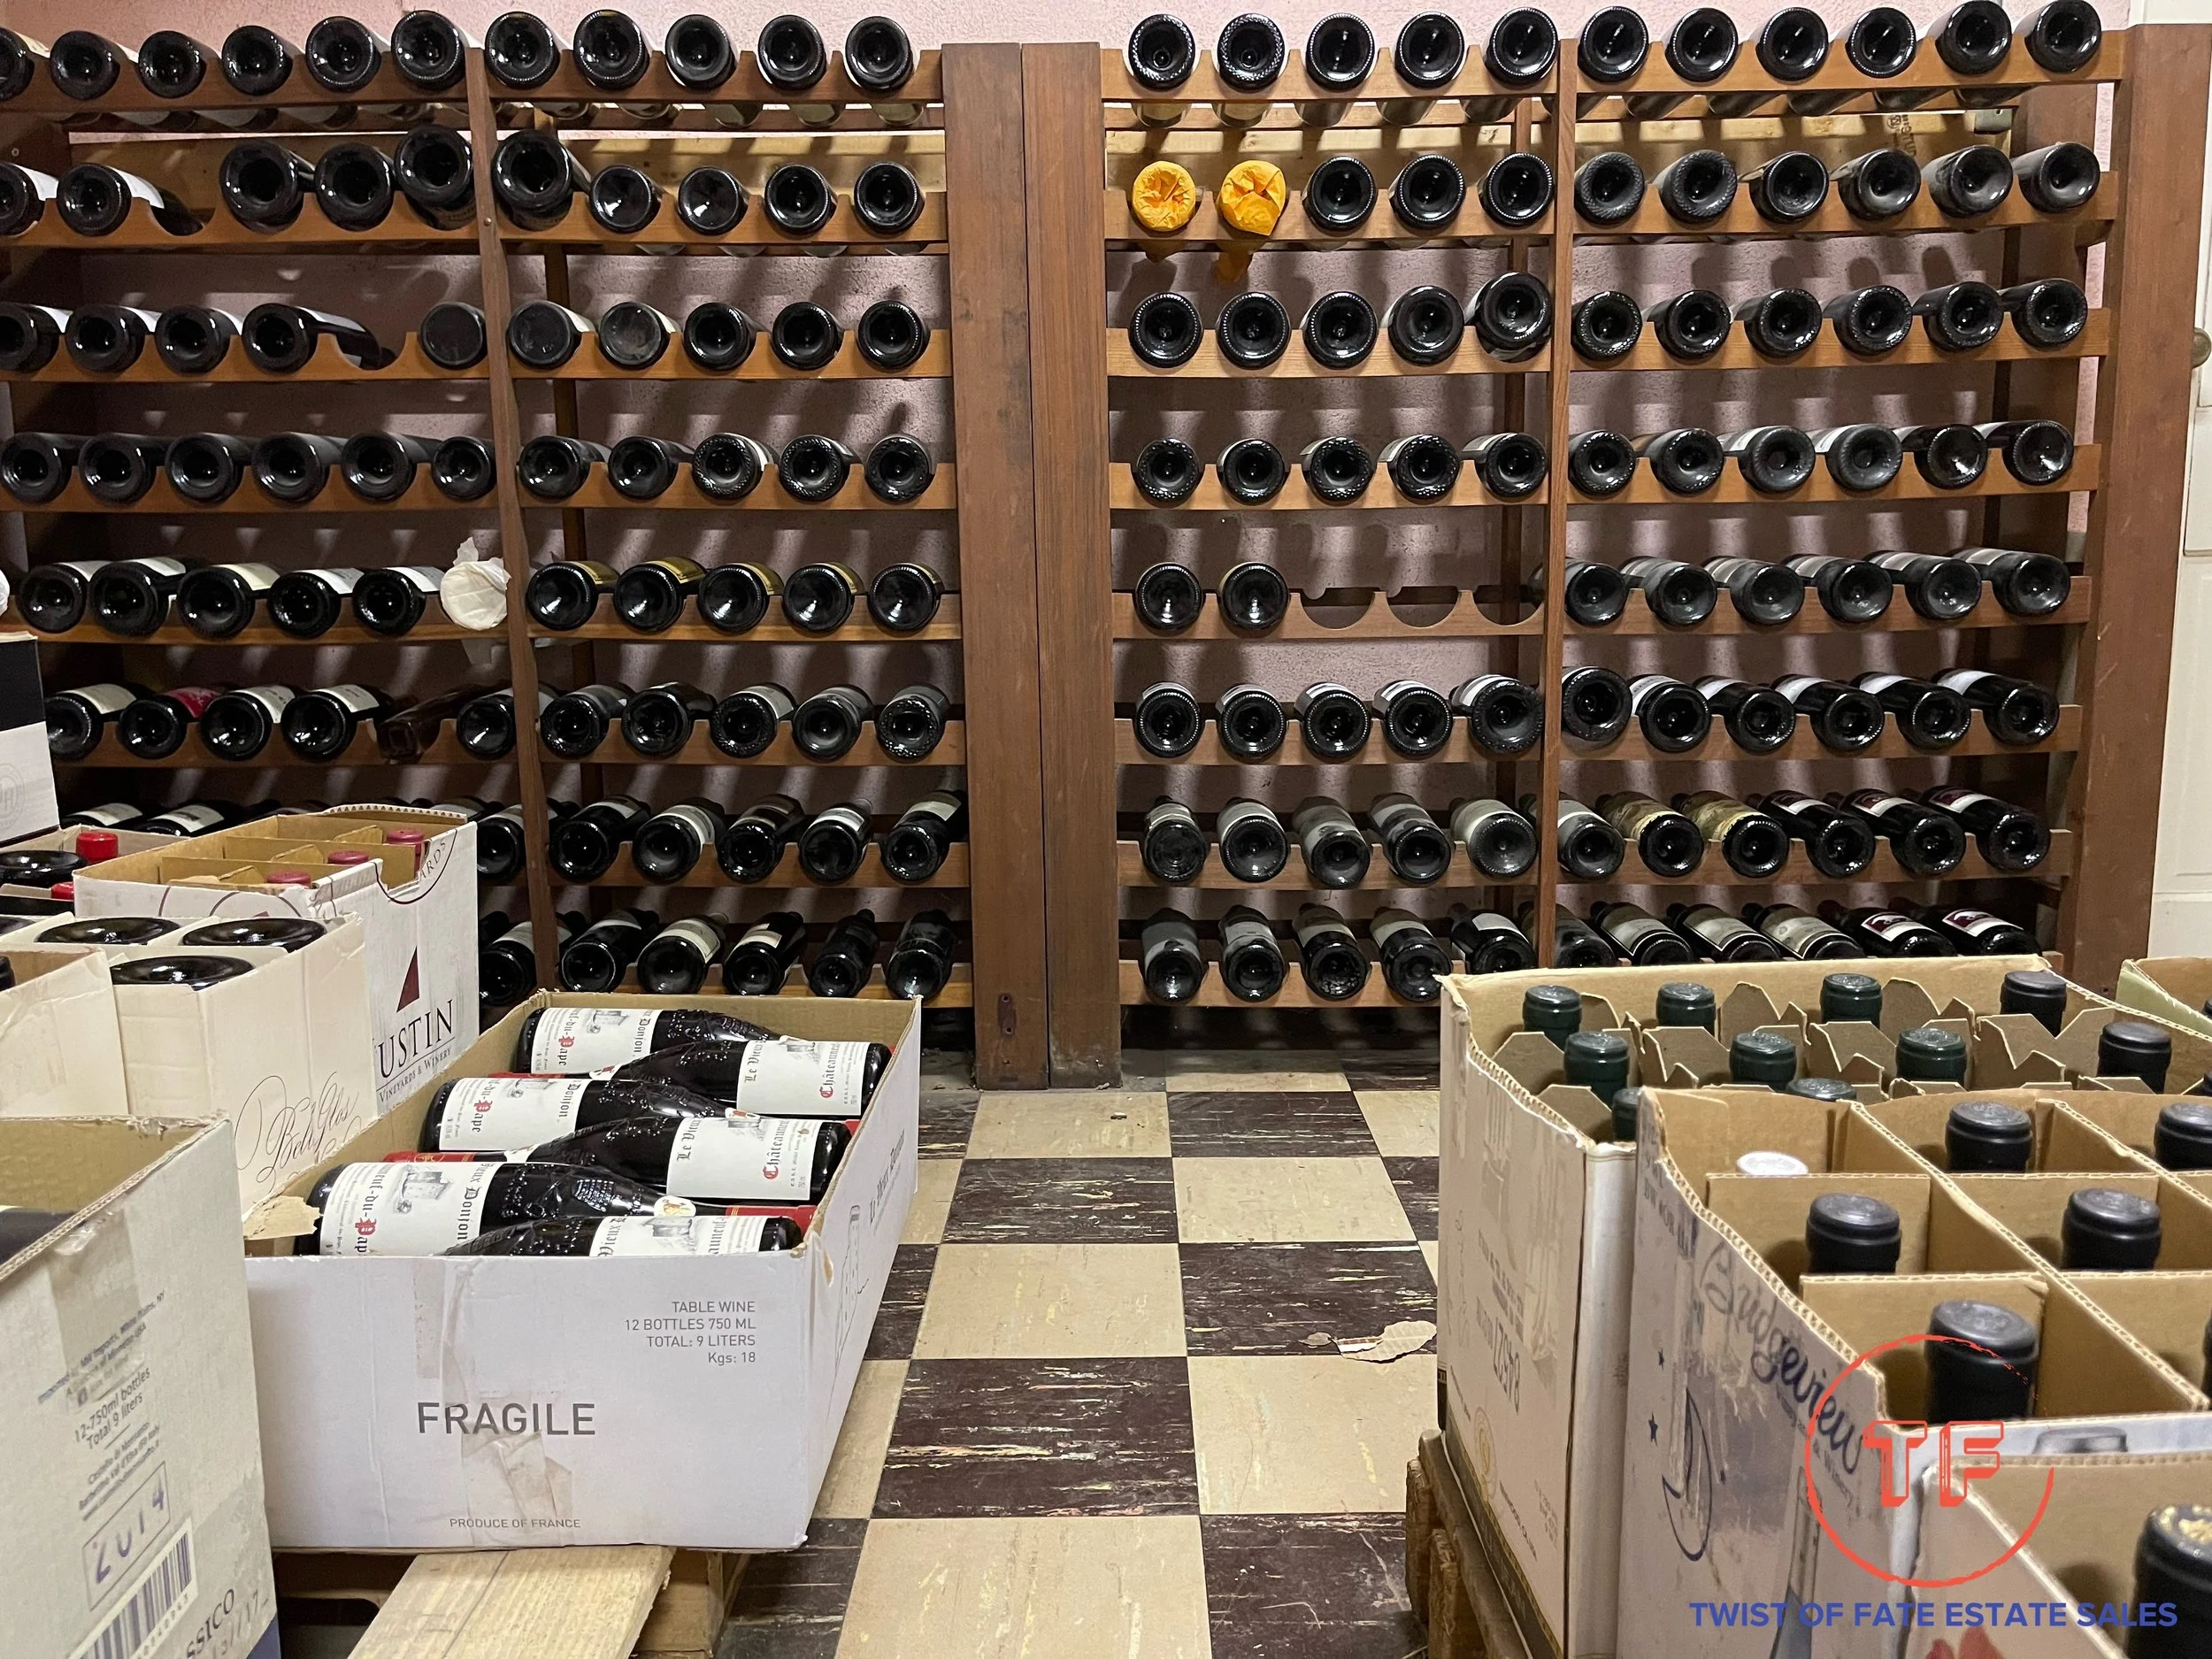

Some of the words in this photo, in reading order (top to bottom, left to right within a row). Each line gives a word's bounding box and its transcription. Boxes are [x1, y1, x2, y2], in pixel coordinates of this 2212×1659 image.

[373, 999, 453, 1079] USTIN
[457, 1187, 481, 1240] Donjon
[672, 1301, 716, 1313] TABLE
[718, 1301, 756, 1313] WINE
[625, 1318, 640, 1331] 12
[643, 1318, 704, 1331] BOTTLES
[709, 1317, 732, 1330] 750
[735, 1317, 757, 1330] ML
[647, 1335, 693, 1348] TOTAL:
[696, 1335, 704, 1347] 9
[709, 1334, 756, 1347] LITERS
[708, 1352, 737, 1366] Kgs:
[741, 1351, 756, 1363] 18
[75, 1393, 119, 1443] 12-750ml
[121, 1367, 150, 1401] bottles
[87, 1418, 111, 1449] Total
[112, 1411, 119, 1427] 9
[121, 1392, 142, 1419] liters
[418, 1402, 596, 1435] FRAGILE
[449, 1517, 508, 1528] PRODUCE
[511, 1517, 528, 1528] OF
[531, 1517, 581, 1528] FRANCE
